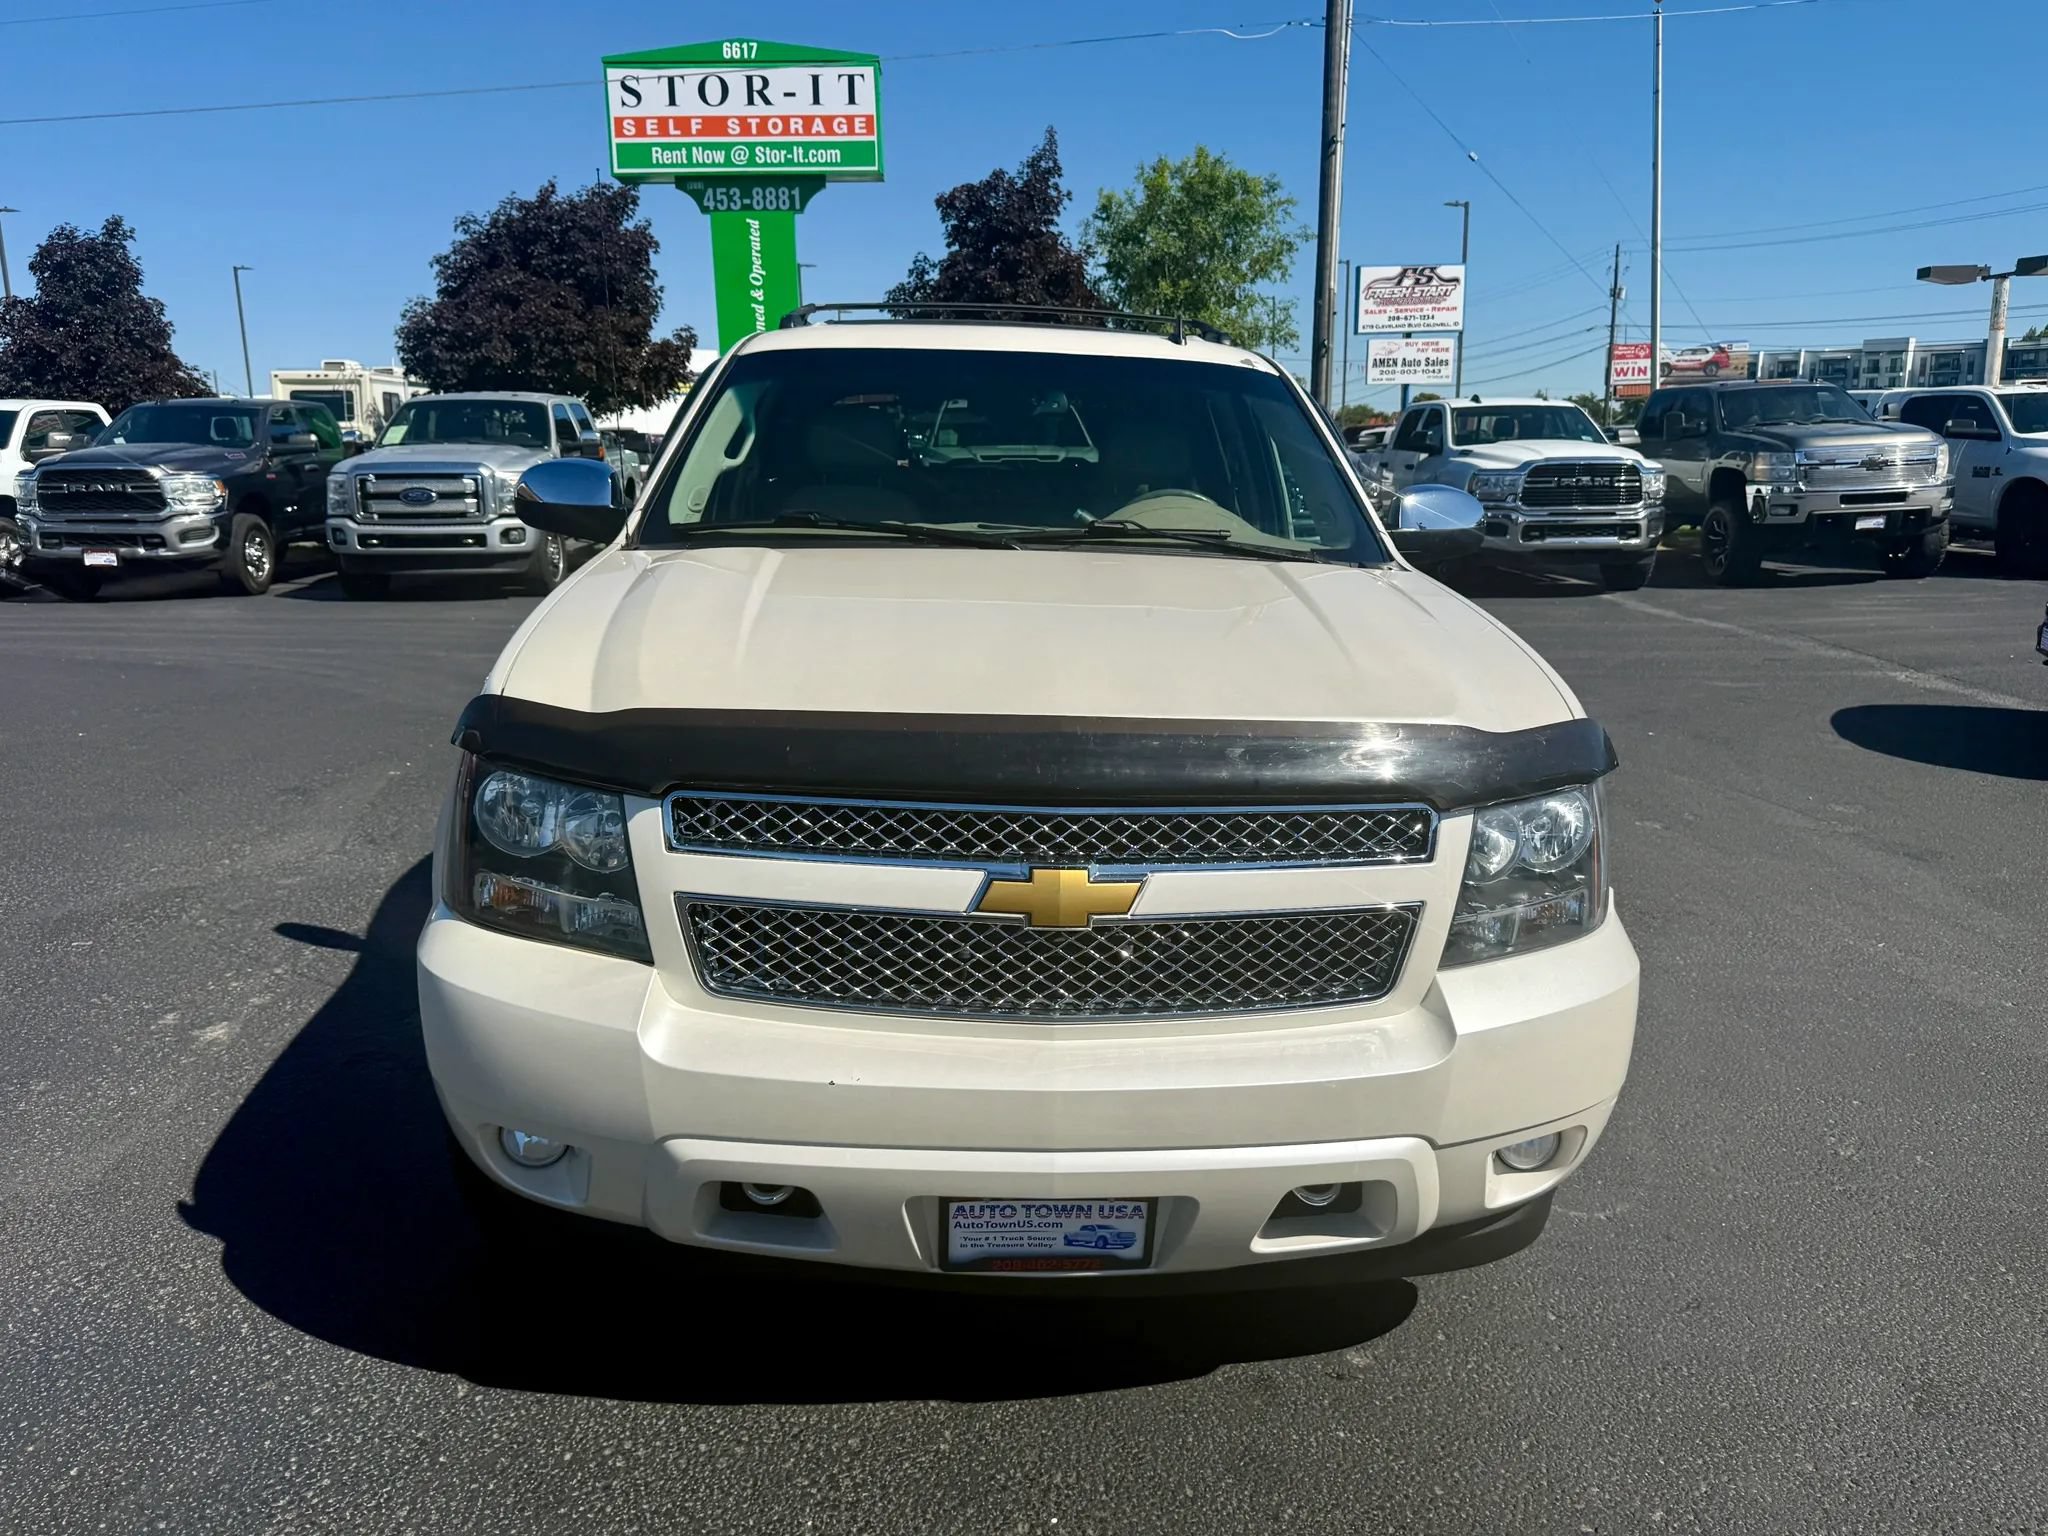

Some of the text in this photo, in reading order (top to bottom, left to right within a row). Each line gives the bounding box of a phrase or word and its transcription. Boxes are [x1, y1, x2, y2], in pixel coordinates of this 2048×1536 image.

[722, 42, 758, 59] 6617
[620, 73, 865, 108] STOR-IT
[622, 116, 868, 136] SELF STORAGE
[651, 145, 842, 165] Rent Now @ Stor-It.com
[702, 186, 801, 211] 453-8881
[745, 217, 767, 333] ned & Operated
[1364, 284, 1457, 300] FRESH START
[1394, 306, 1425, 314] SERVICE
[1431, 305, 1458, 313] REPAIR
[1371, 356, 1449, 369] AMEN Auto Sales
[1614, 365, 1648, 377] WIN
[69, 484, 123, 492] RAM
[952, 1204, 1145, 1220] AUTO TOWN USA
[953, 1220, 1063, 1230] AutoTownUS.com
